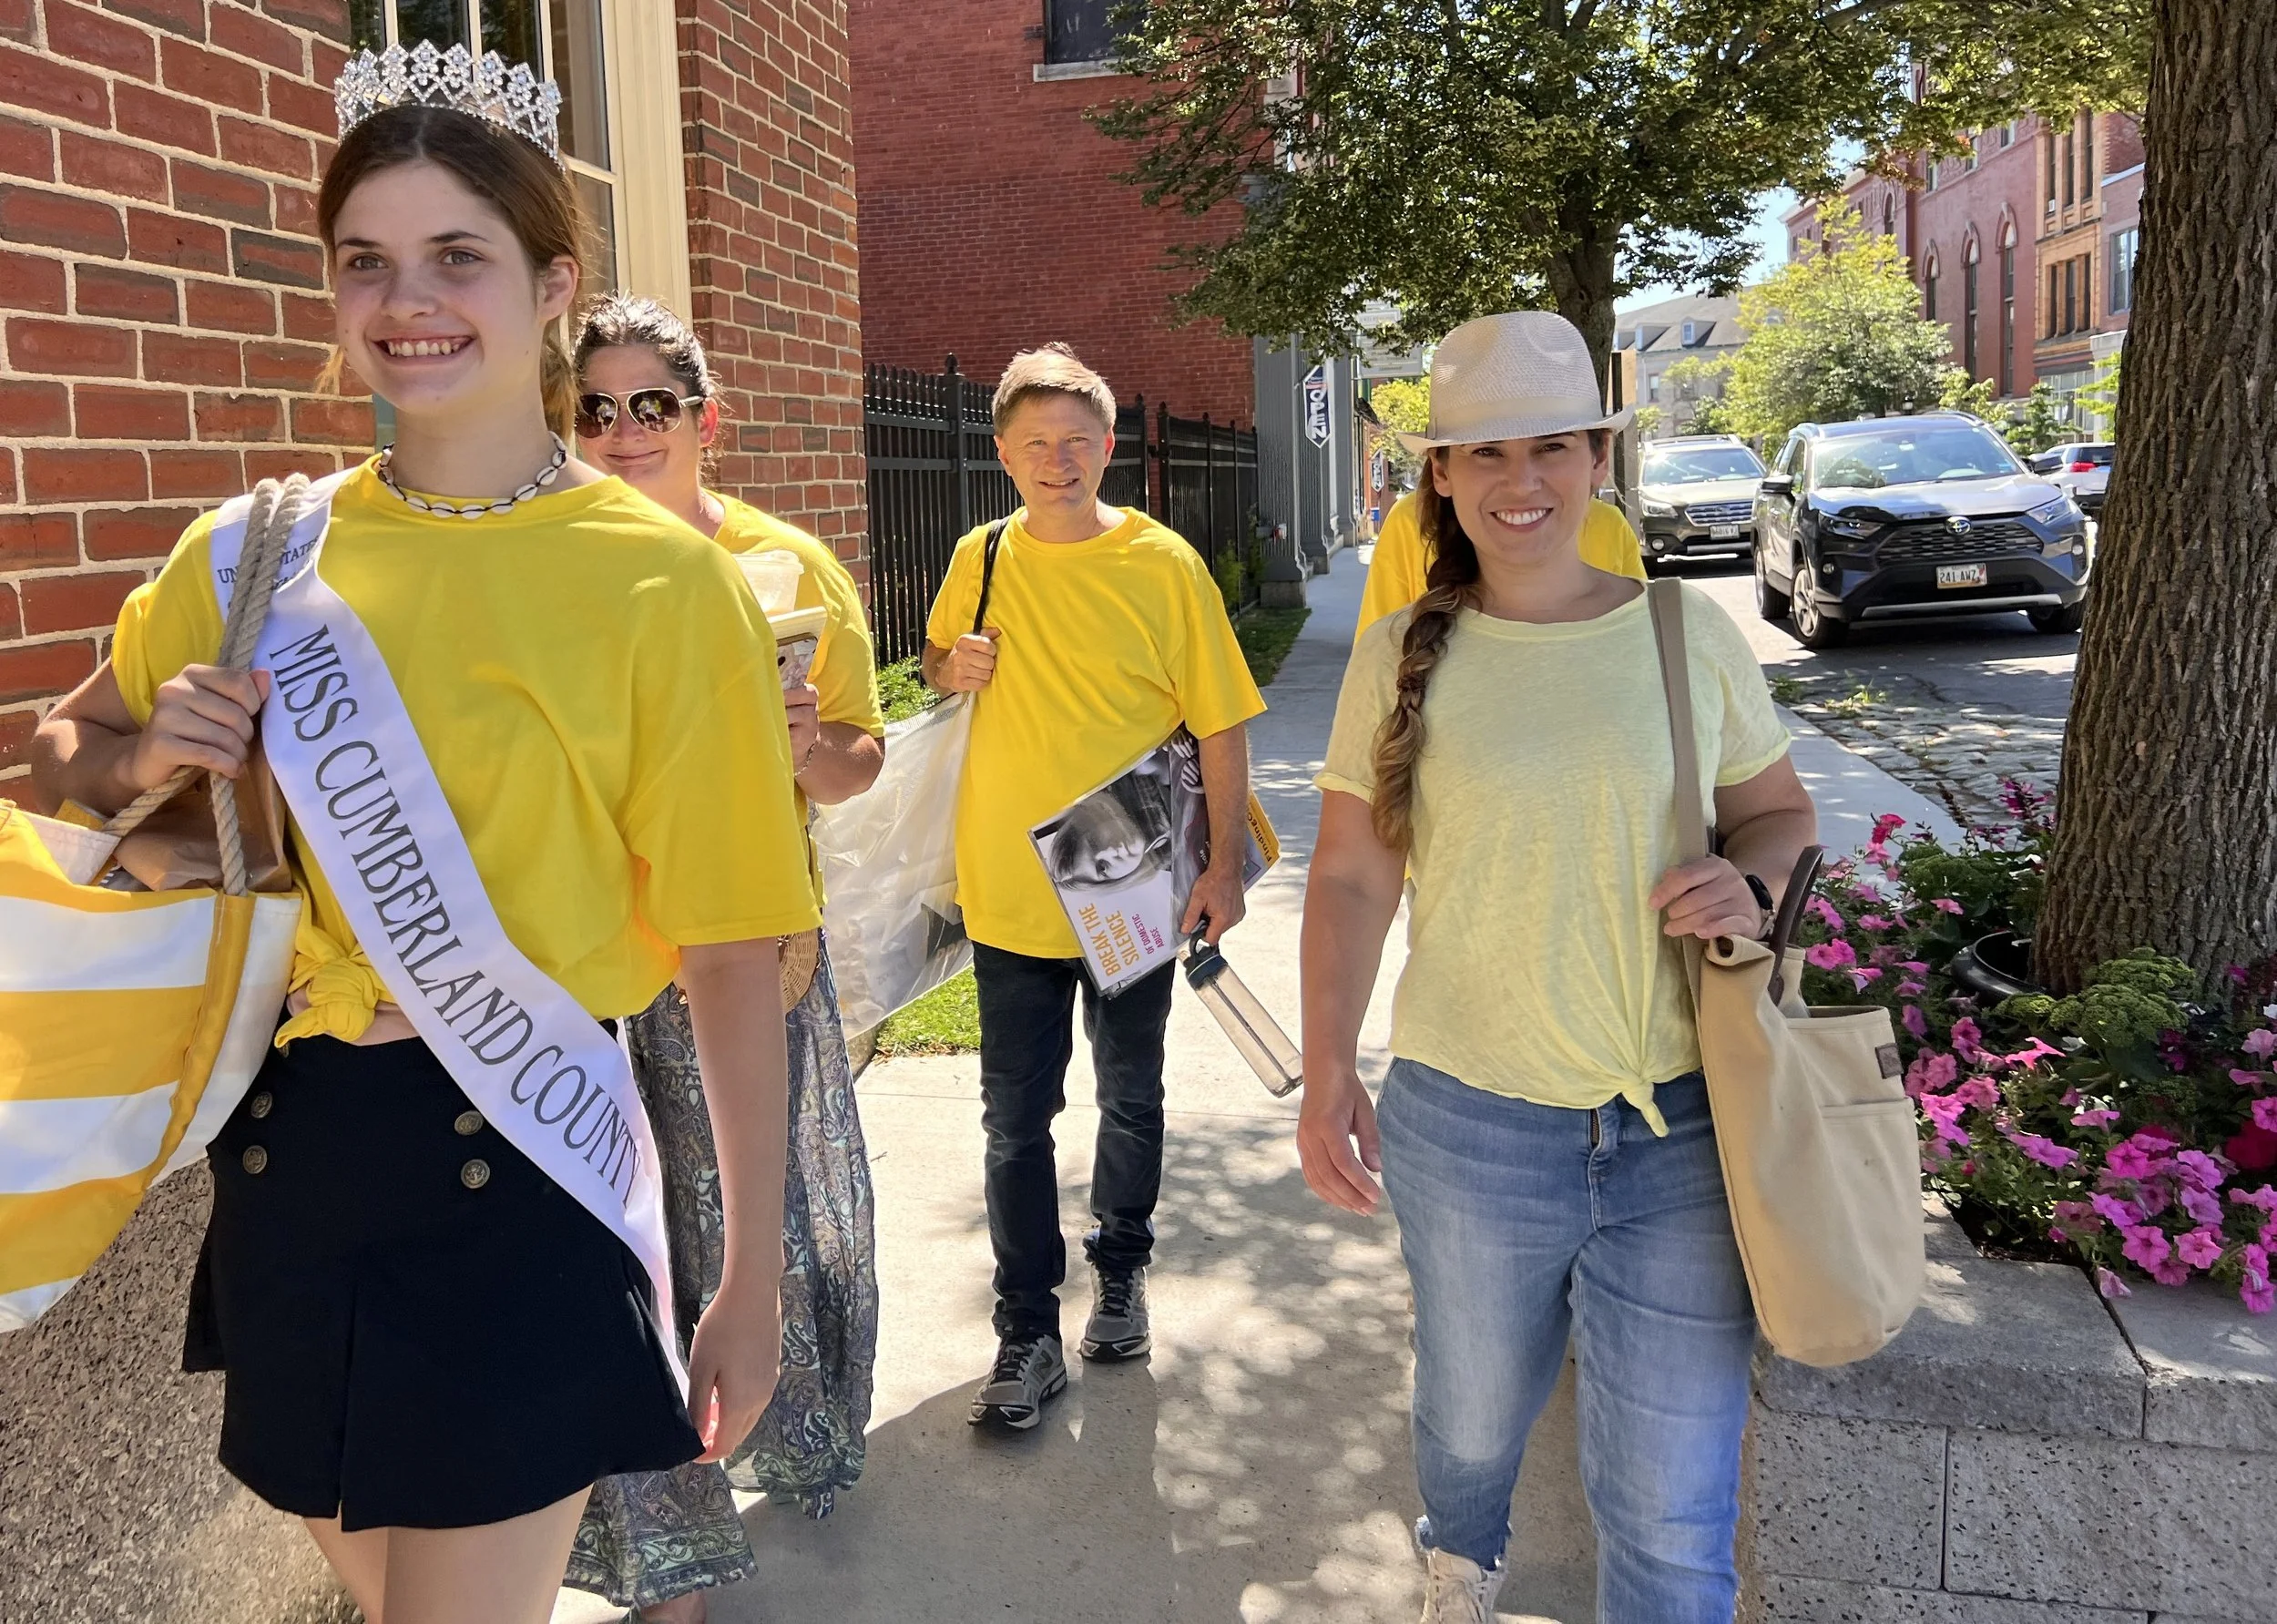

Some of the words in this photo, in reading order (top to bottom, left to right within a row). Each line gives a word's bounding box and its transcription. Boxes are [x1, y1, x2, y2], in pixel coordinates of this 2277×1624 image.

[1308, 389, 1327, 440] OPEN
[278, 535, 319, 565] TATE
[269, 624, 359, 741] MISS
[315, 741, 534, 1066] CUMBERLAND
[510, 1044, 640, 1209] COUNTY
[1077, 903, 1101, 933] THE
[1131, 914, 1151, 946] DOMESTIC
[1090, 929, 1122, 976] BREAK
[1105, 910, 1140, 965] SILENCE
[1145, 945, 1155, 955] OF
[1149, 926, 1165, 948] ABUSE
